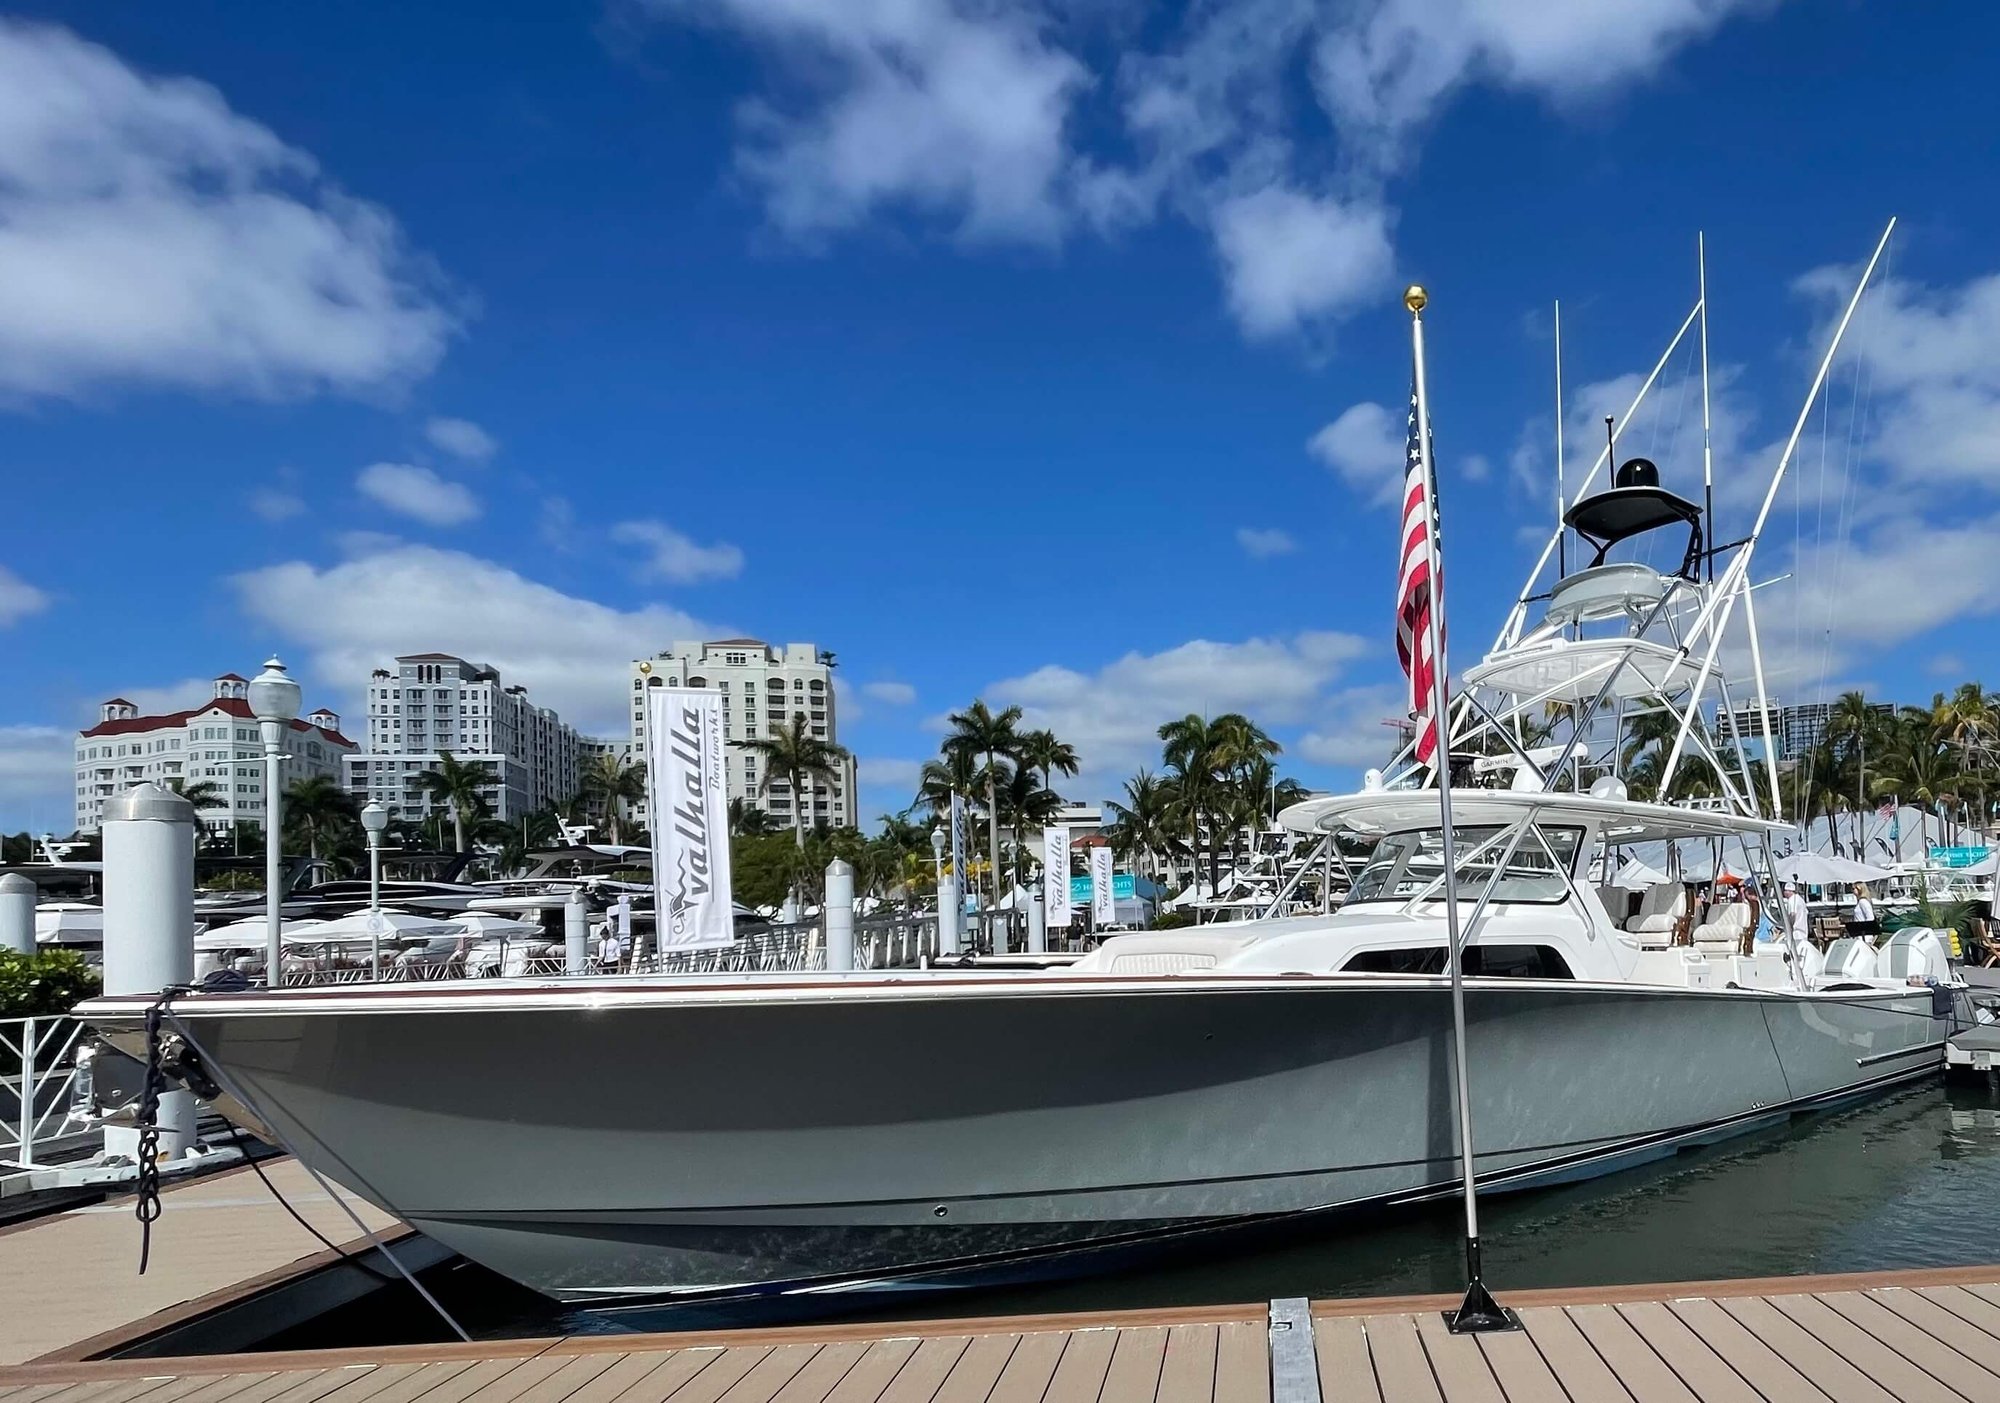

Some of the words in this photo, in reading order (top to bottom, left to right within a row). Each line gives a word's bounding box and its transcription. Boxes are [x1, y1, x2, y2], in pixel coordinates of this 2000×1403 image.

[707, 709, 720, 790] Boatworks
[1481, 759, 1509, 768] GARMIN
[670, 707, 710, 896] valhalla
[1050, 835, 1063, 906] valhalla
[1097, 854, 1108, 906] valhalla
[1112, 881, 1132, 889] CHTS
